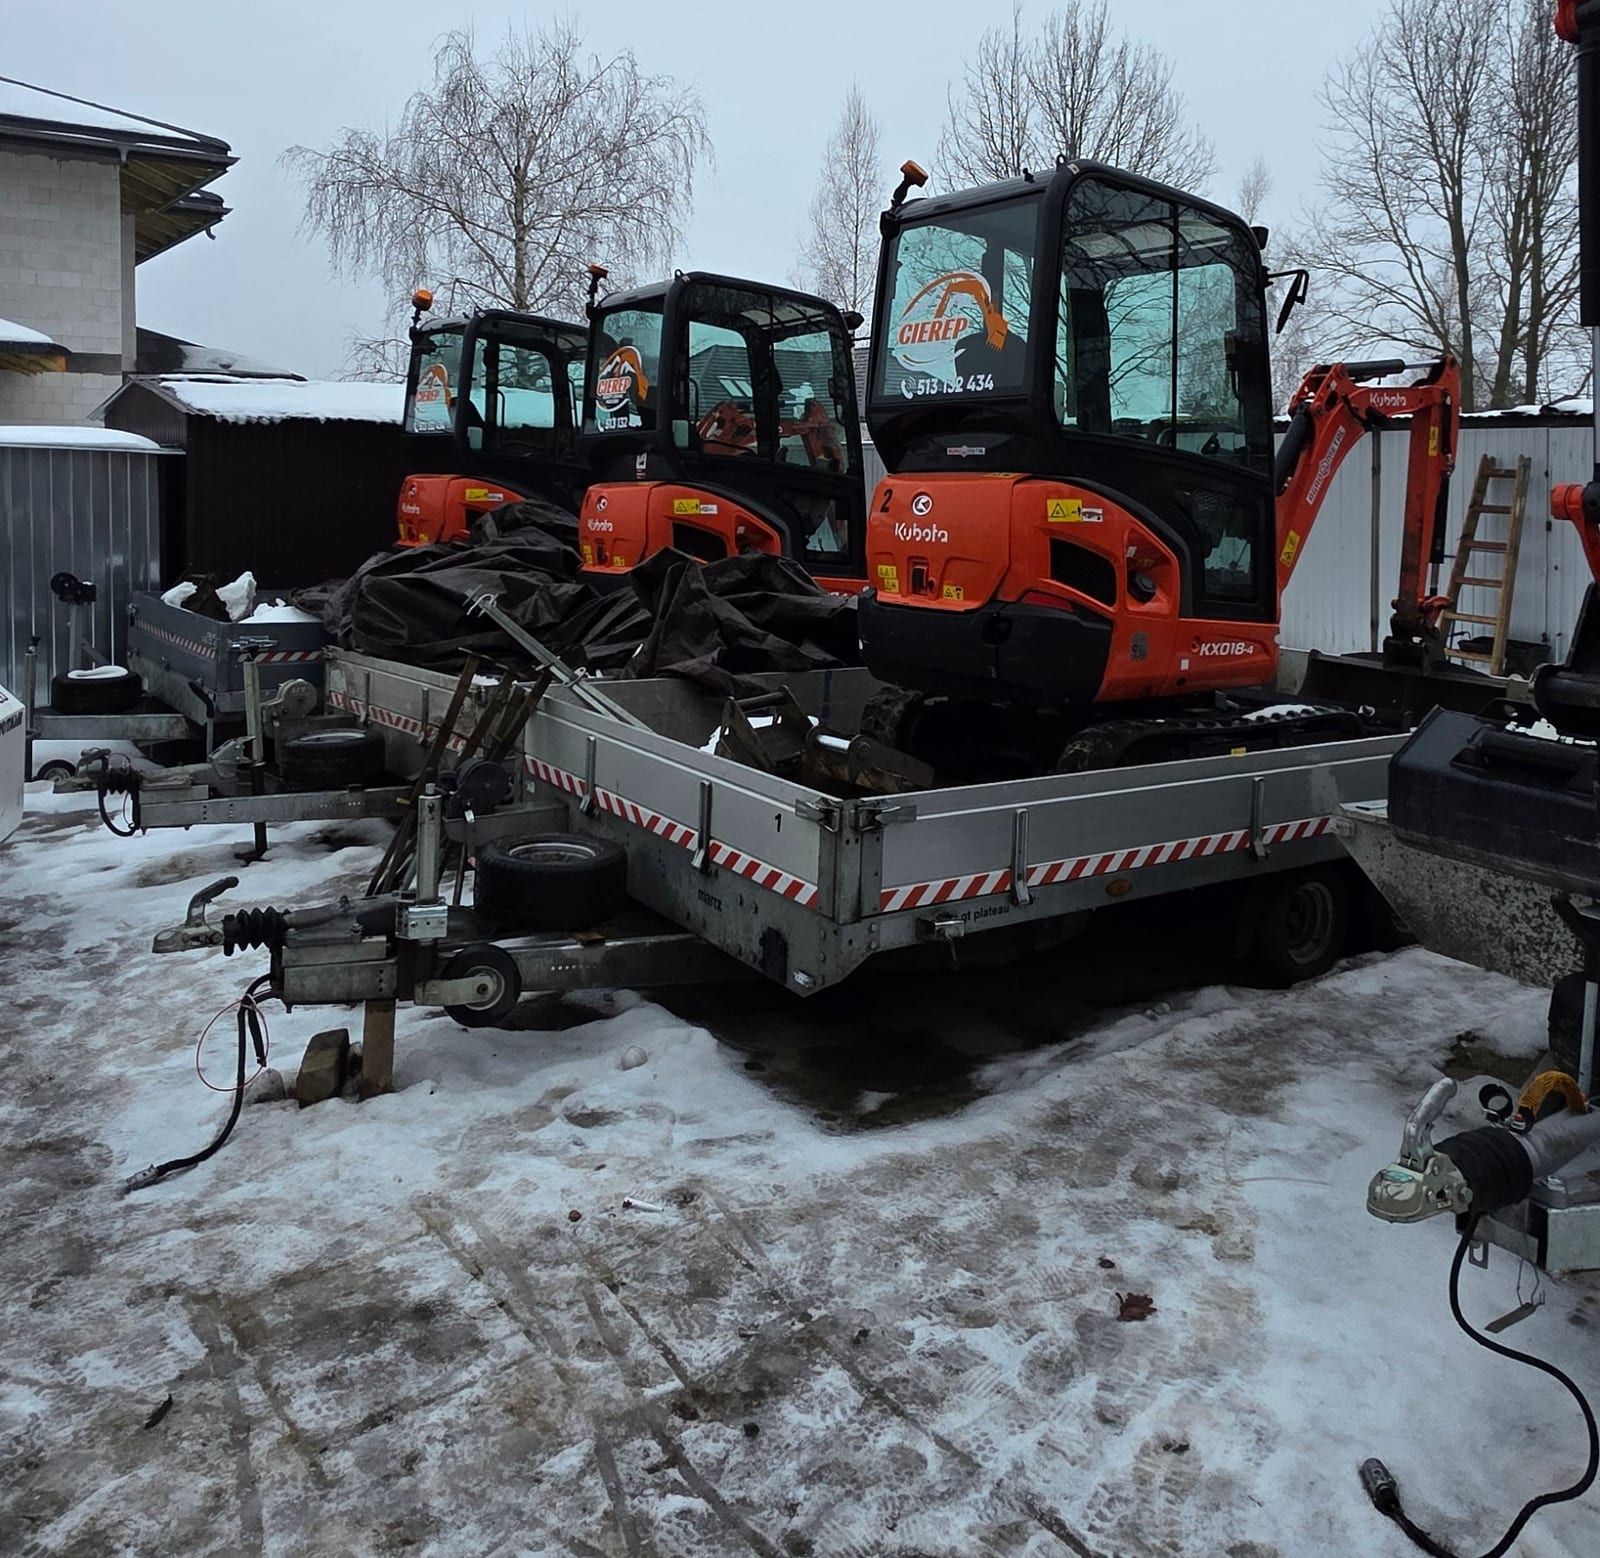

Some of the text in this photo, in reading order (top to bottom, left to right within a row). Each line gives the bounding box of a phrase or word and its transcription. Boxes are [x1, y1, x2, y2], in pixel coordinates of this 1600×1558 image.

[898, 317, 968, 345] CIEREP
[598, 377, 631, 396] CIEREP
[917, 379, 939, 396] 513
[966, 373, 995, 392] 434
[1369, 392, 1407, 407] Kubota
[880, 488, 893, 513] 2
[588, 517, 614, 532] Kubota
[894, 522, 949, 543] Kubota
[1200, 642, 1254, 656] KX018-4
[774, 812, 783, 833] 1
[697, 889, 723, 913] martz
[973, 905, 1011, 922] plateau
